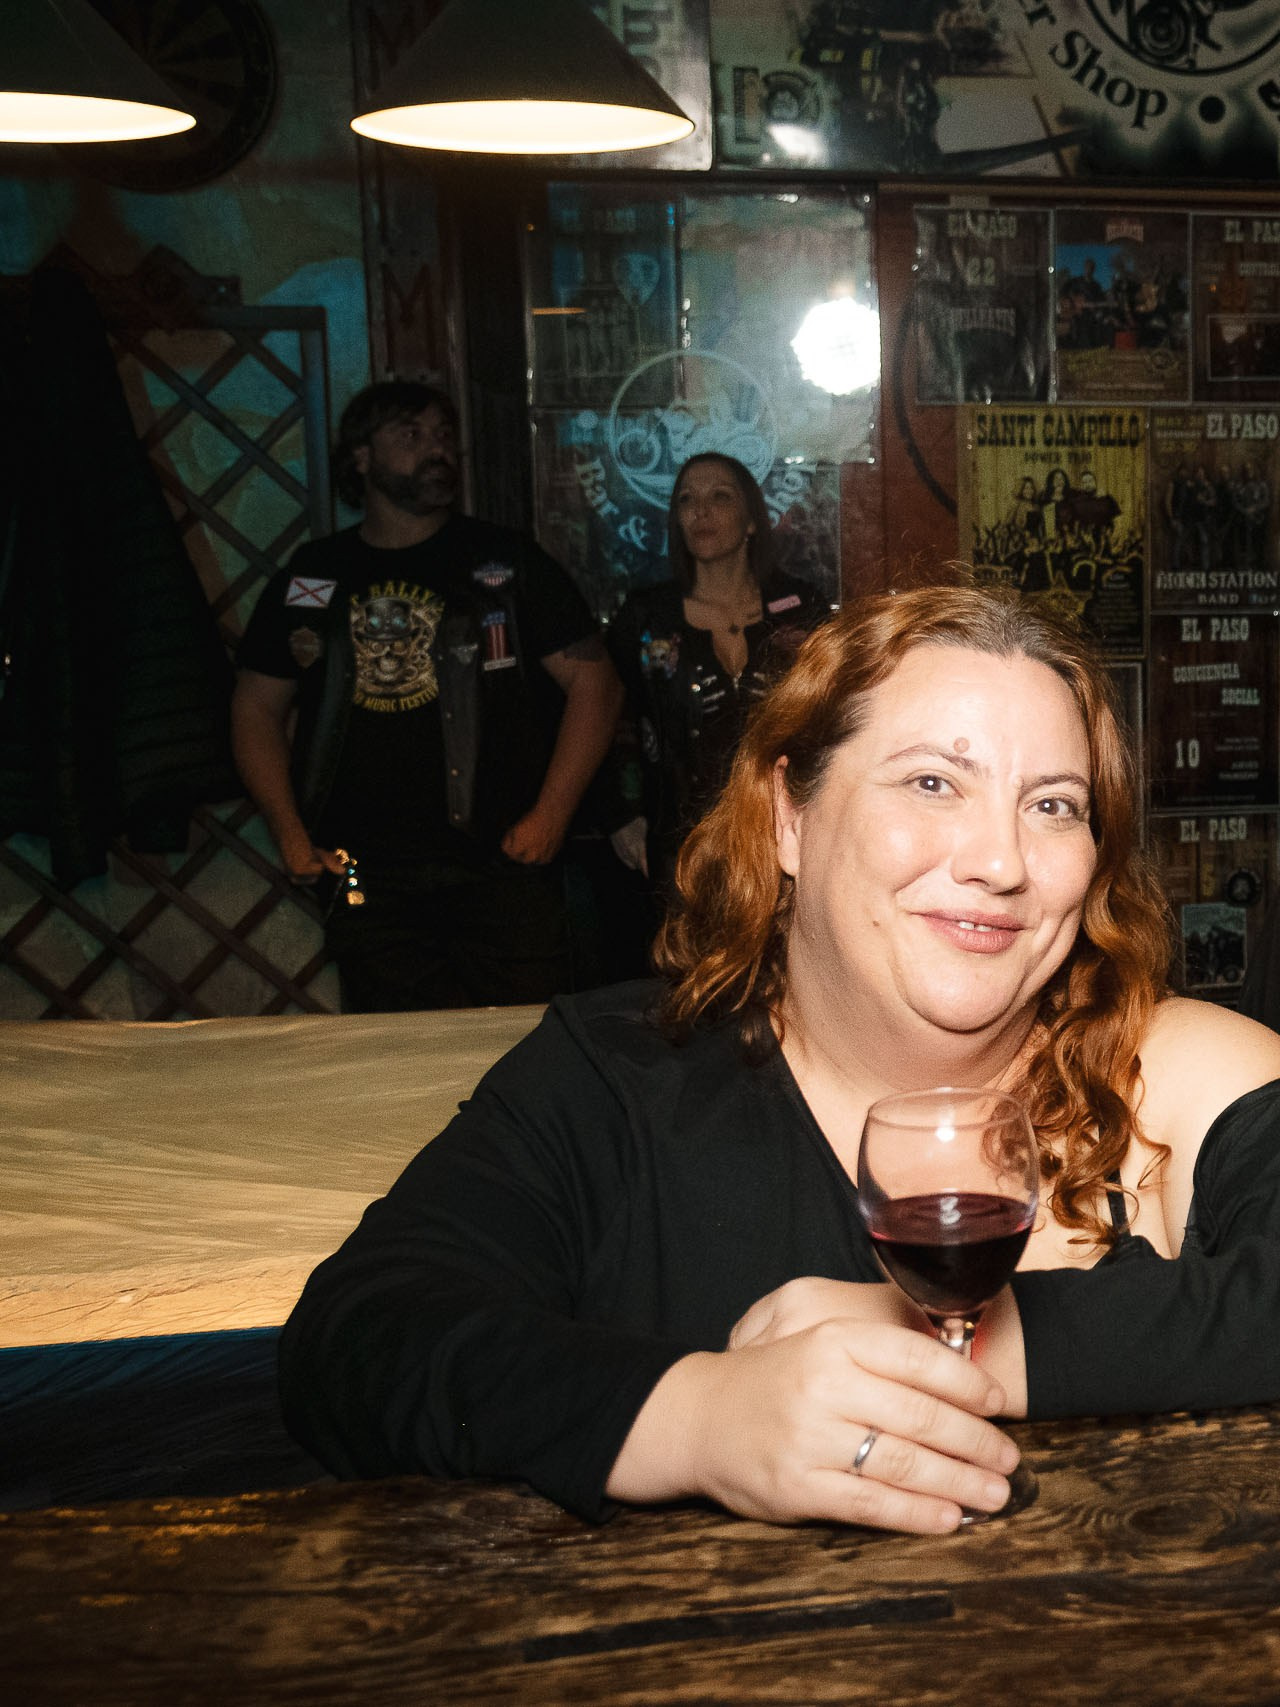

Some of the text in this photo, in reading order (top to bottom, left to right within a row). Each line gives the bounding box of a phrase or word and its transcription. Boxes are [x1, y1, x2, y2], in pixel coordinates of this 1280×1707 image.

[1048, 30, 1168, 128] Shop
[1224, 220, 1244, 243] EL
[977, 414, 1140, 448] SANTI CAMPILLO
[1206, 413, 1280, 439] EL PASO
[575, 457, 620, 519] Bar
[1208, 570, 1279, 589] STATION
[1198, 593, 1240, 605] BAND
[1181, 617, 1250, 643] EL PASO
[1172, 662, 1241, 685] CONCIENCIA
[362, 696, 397, 713] MUSIC
[1221, 687, 1261, 706] SOCIAL
[1175, 738, 1200, 769] 10
[1179, 816, 1248, 843] EL PASO
